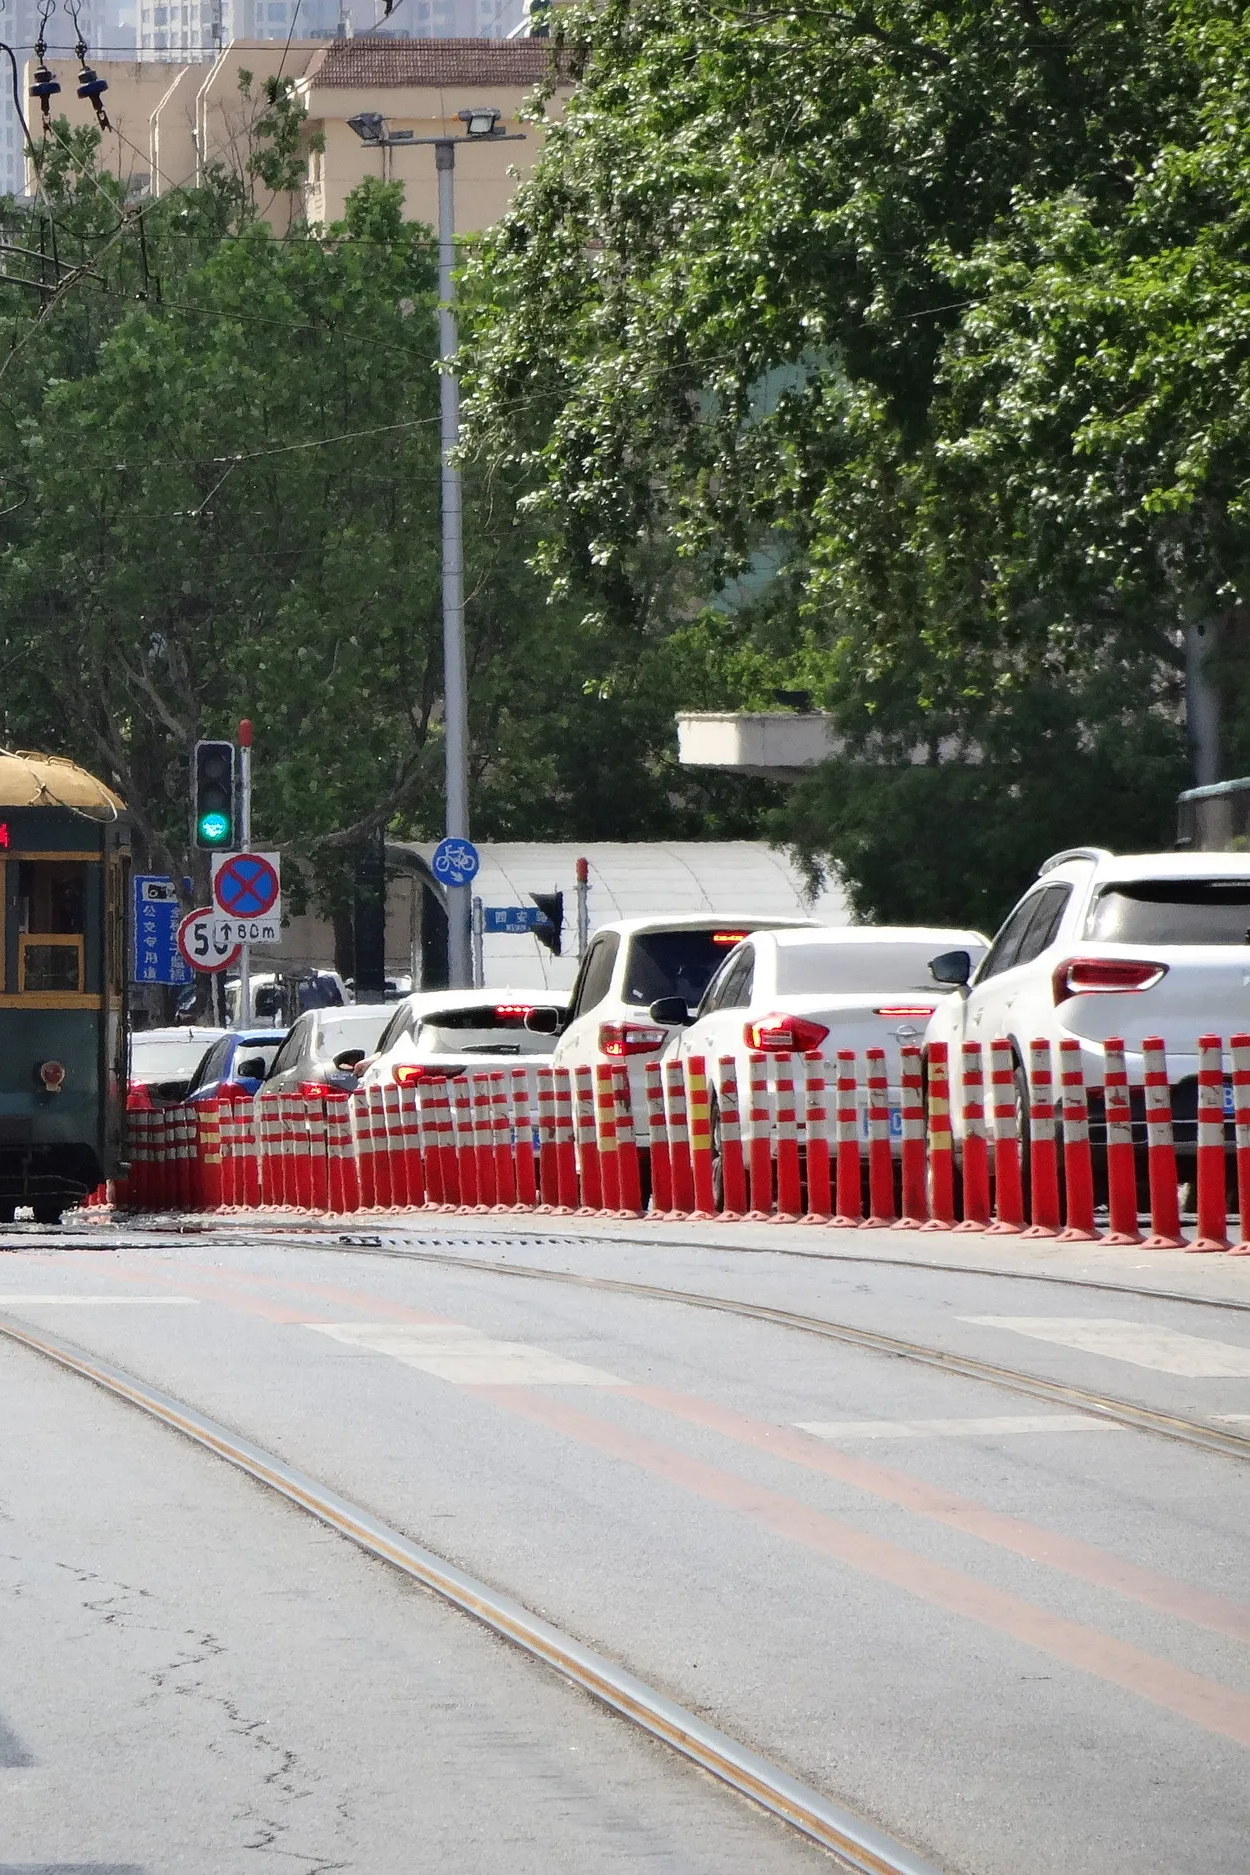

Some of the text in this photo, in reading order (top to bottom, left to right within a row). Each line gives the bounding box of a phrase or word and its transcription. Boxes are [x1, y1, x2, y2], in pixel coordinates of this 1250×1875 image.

[141, 904, 159, 980] 公交专用道
[237, 923, 275, 939] 80m
